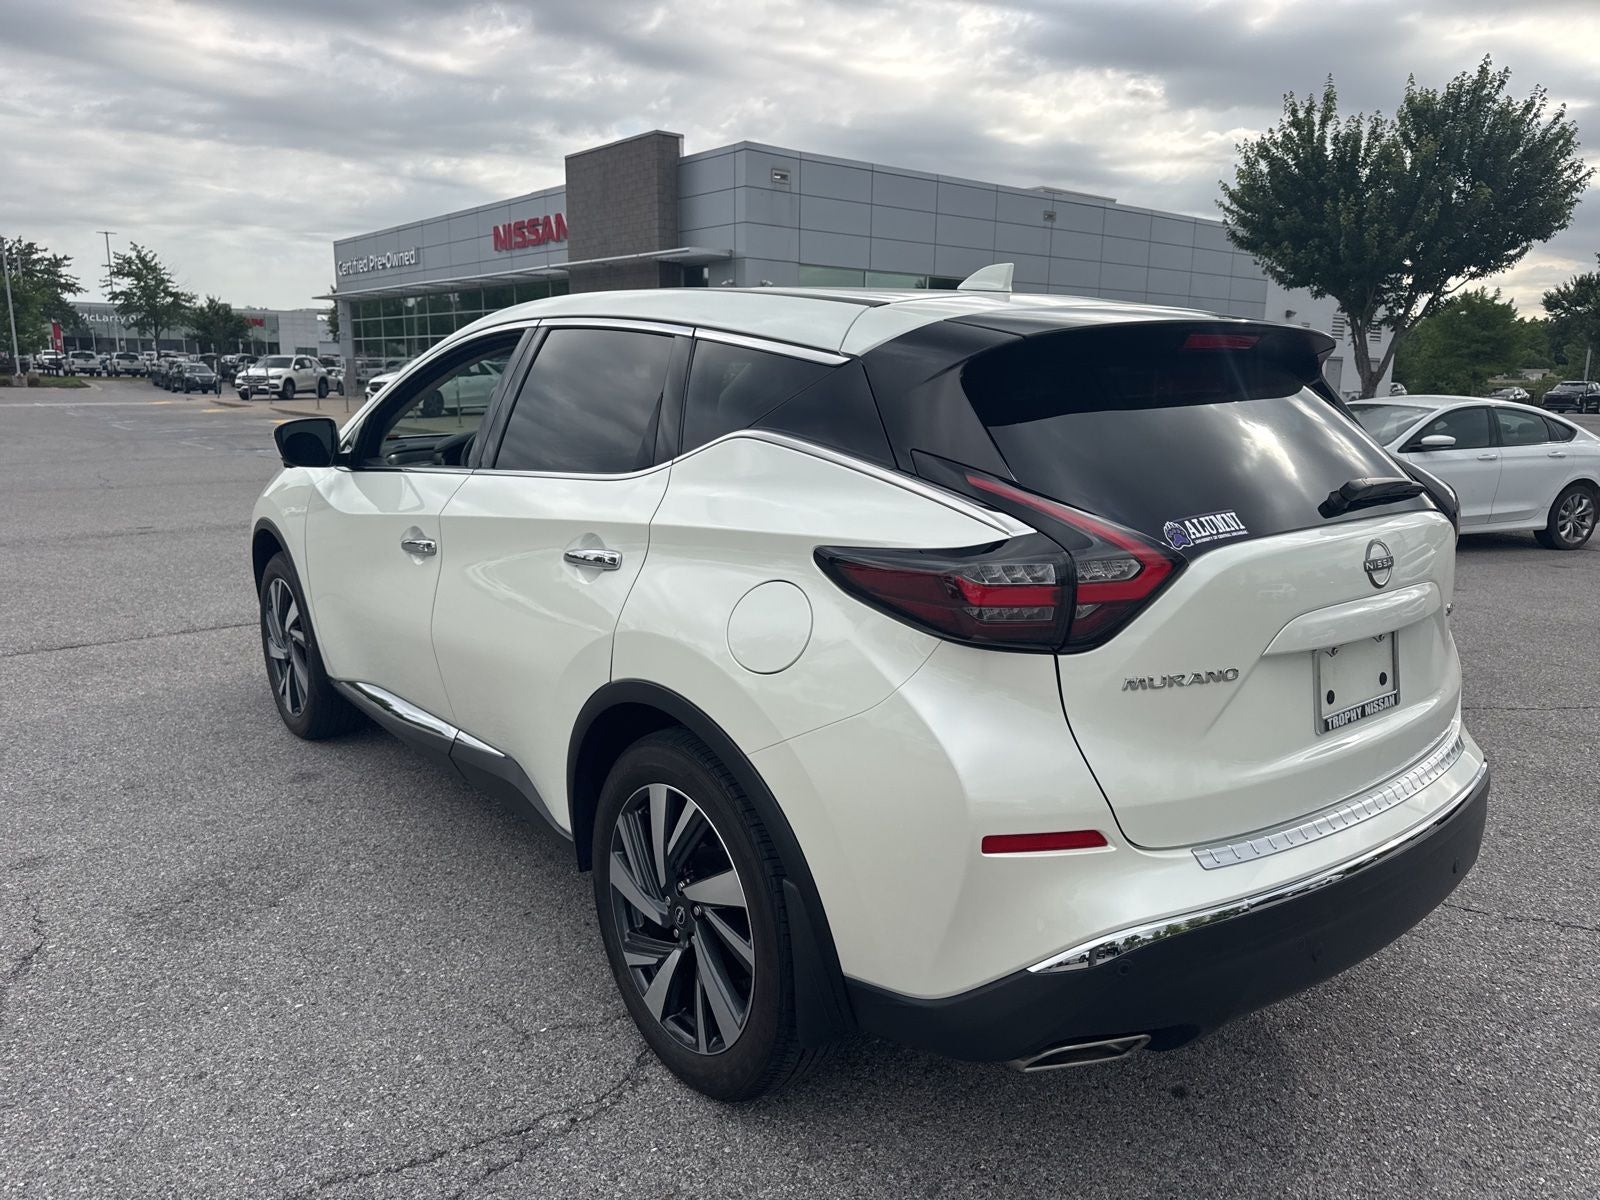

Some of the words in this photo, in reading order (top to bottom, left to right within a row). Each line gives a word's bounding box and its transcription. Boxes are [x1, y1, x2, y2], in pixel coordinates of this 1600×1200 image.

[337, 256, 368, 276] Certified
[369, 247, 416, 271] Pre-Owned
[1184, 512, 1246, 539] ALUMNI
[1122, 668, 1239, 691] MURANO
[1327, 706, 1362, 730] TROPHY
[1364, 694, 1395, 716] NISSAN
